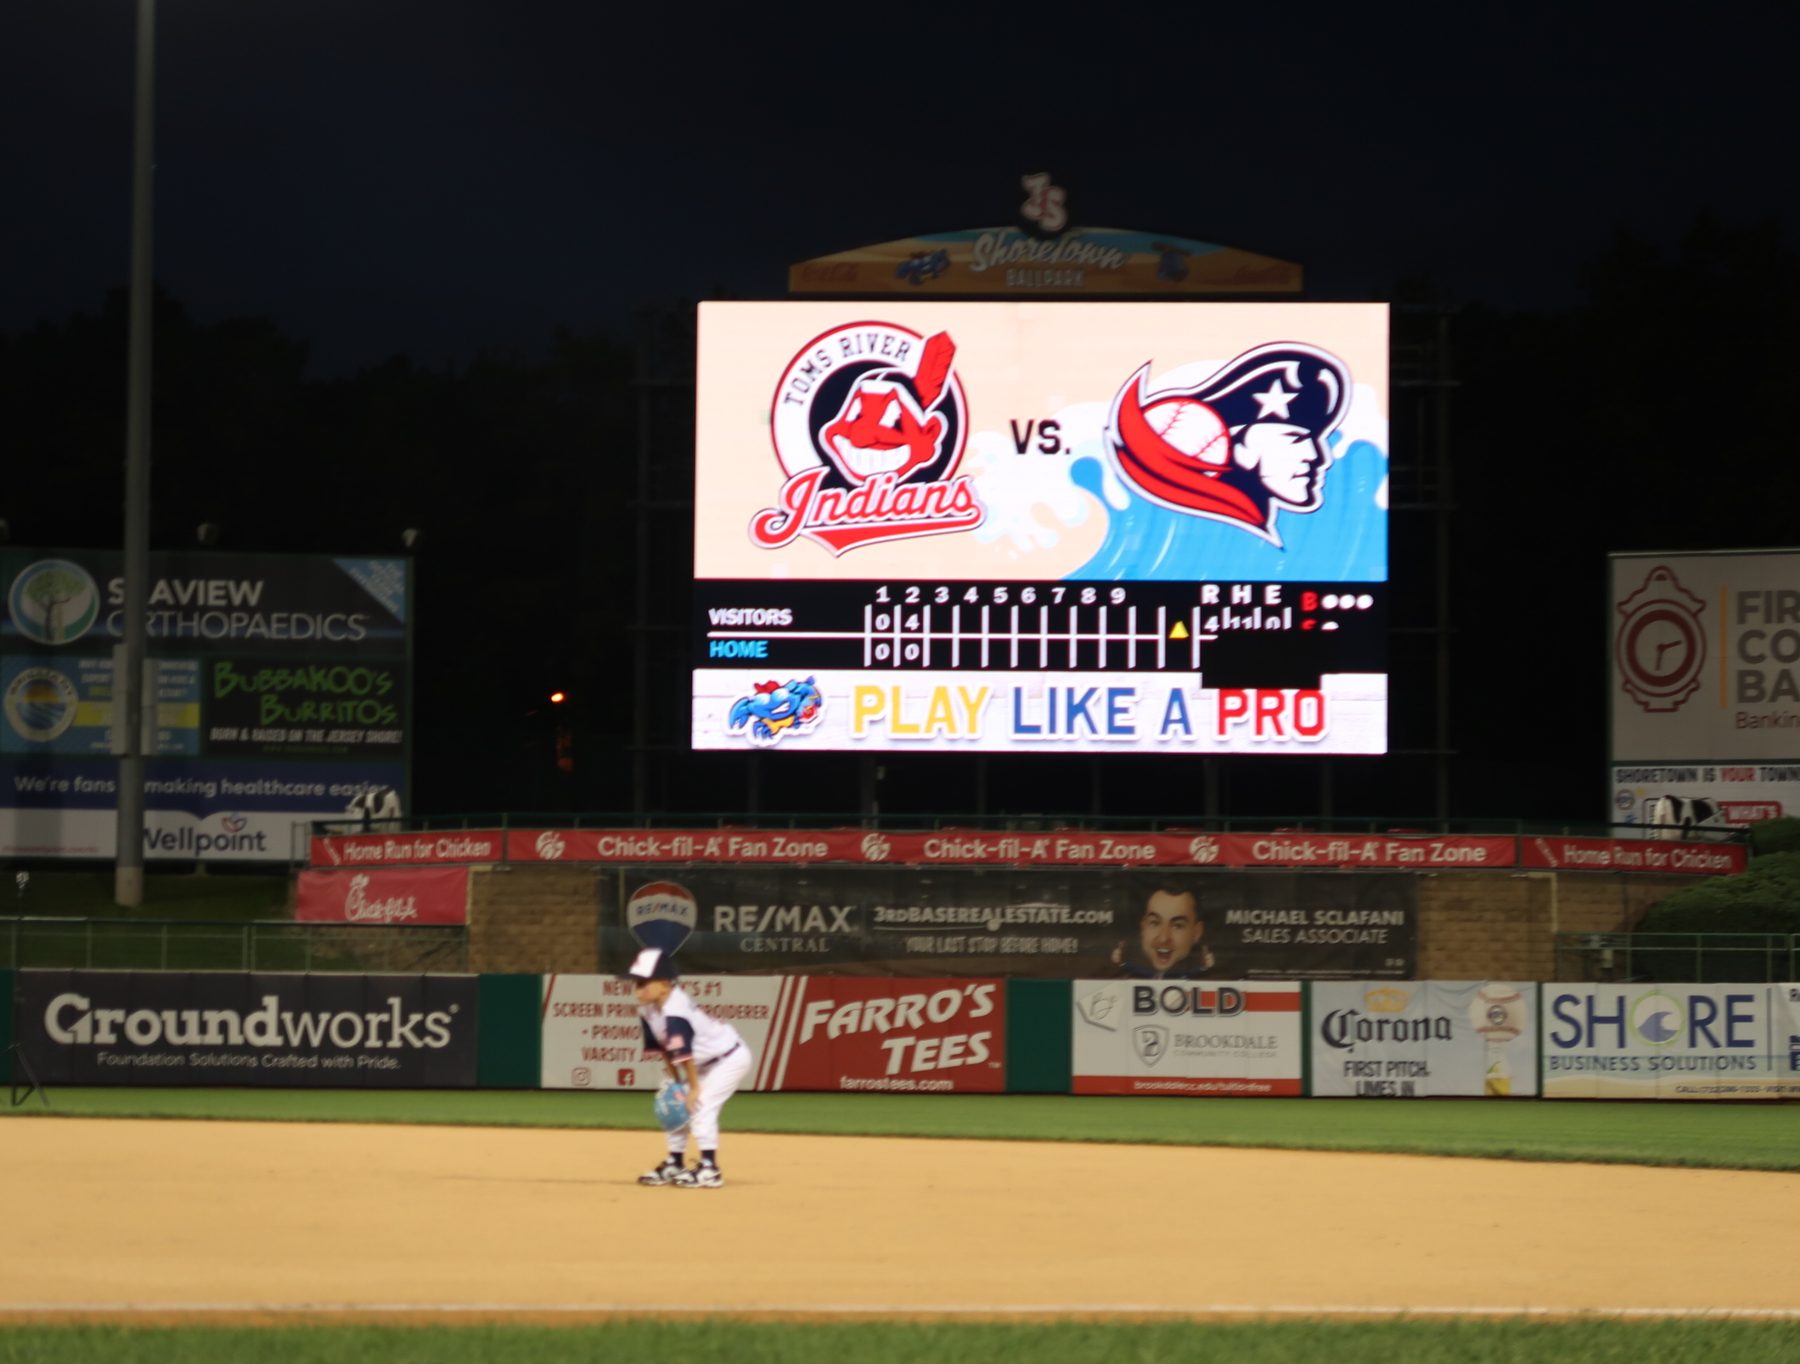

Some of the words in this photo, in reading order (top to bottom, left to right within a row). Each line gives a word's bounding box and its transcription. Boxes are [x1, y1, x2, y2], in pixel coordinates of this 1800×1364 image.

[1005, 268, 1084, 288] BALLPARK
[783, 349, 834, 406] TOMS
[838, 333, 911, 361] RIVER
[1009, 419, 1071, 455] VS.
[749, 466, 986, 549] Indians
[106, 577, 264, 607] SAVIEW
[876, 586, 891, 602] 1
[905, 586, 920, 603] 2
[934, 586, 950, 604] 3
[963, 586, 979, 603] 4
[993, 587, 1008, 604] 5
[1021, 587, 1036, 604] 6
[1051, 587, 1066, 604] 7
[1081, 587, 1096, 604] 8
[1110, 587, 1126, 605] 9
[1201, 584, 1220, 605] R
[1231, 584, 1252, 605] H
[1265, 584, 1282, 605] E
[1301, 591, 1318, 612] B
[708, 608, 793, 626] VISITORS
[875, 613, 890, 631] 0
[905, 613, 919, 631] 4
[1204, 615, 1220, 632] 4
[709, 640, 768, 658] HOME
[875, 643, 890, 661] 0
[904, 643, 919, 661] 0
[853, 684, 991, 736] PLAY
[1013, 686, 1136, 736] LIKE
[1161, 687, 1193, 736] A
[1217, 690, 1327, 736] PRO
[1616, 768, 1697, 783] SHORETOWN
[1703, 768, 1715, 783] IS
[1721, 767, 1756, 782] YOUR
[14, 776, 70, 792] We're
[74, 775, 116, 793] fans
[143, 778, 216, 798] making
[221, 779, 324, 797] healthcare
[343, 841, 383, 861] Home
[383, 840, 410, 860] Run
[413, 839, 434, 859] for
[436, 837, 492, 858] Chicken
[597, 836, 722, 857] Chick-fil-A
[728, 836, 767, 858] Fan
[771, 837, 828, 858] Zone
[923, 838, 1051, 859] Chick-fil-A
[1055, 839, 1095, 859] Fan
[1099, 839, 1156, 860] Zone
[1252, 840, 1378, 861] Chick-fil-A
[1385, 842, 1425, 861] Fan
[1429, 843, 1487, 863] Zone
[1563, 844, 1611, 865] Home
[1614, 846, 1641, 866] Run
[1645, 847, 1668, 867] for
[1670, 848, 1732, 869] Chicken
[637, 902, 689, 917] RE/MAX
[713, 905, 852, 933] RE/MAX
[1225, 910, 1308, 926] MICHAEL
[1314, 910, 1404, 926] SCLAFANI
[740, 937, 829, 953] CENTRAL
[1241, 929, 1290, 944] SALES
[1295, 928, 1389, 945] ASSOCIATE
[704, 981, 722, 996] #1
[553, 1002, 605, 1018] SCREEN
[1132, 986, 1245, 1017] BOLD
[44, 991, 452, 1048] Groundworks
[799, 983, 996, 1045] FARRO'S
[1174, 1034, 1279, 1049] BROOKDALE
[1321, 1009, 1453, 1052] Corona
[97, 1052, 185, 1067] Foundation
[189, 1053, 258, 1069] Solutions
[261, 1053, 319, 1069] Crafted
[321, 1054, 354, 1069] with
[357, 1054, 401, 1071] Pride.
[581, 1047, 637, 1063] VARSITY
[881, 1031, 992, 1075] TEES
[1550, 1056, 1640, 1071] BUSINESS
[1649, 1055, 1757, 1071] SOLUTIONS
[1344, 1061, 1384, 1077] FIRST
[840, 1076, 954, 1090] farrostees.com
